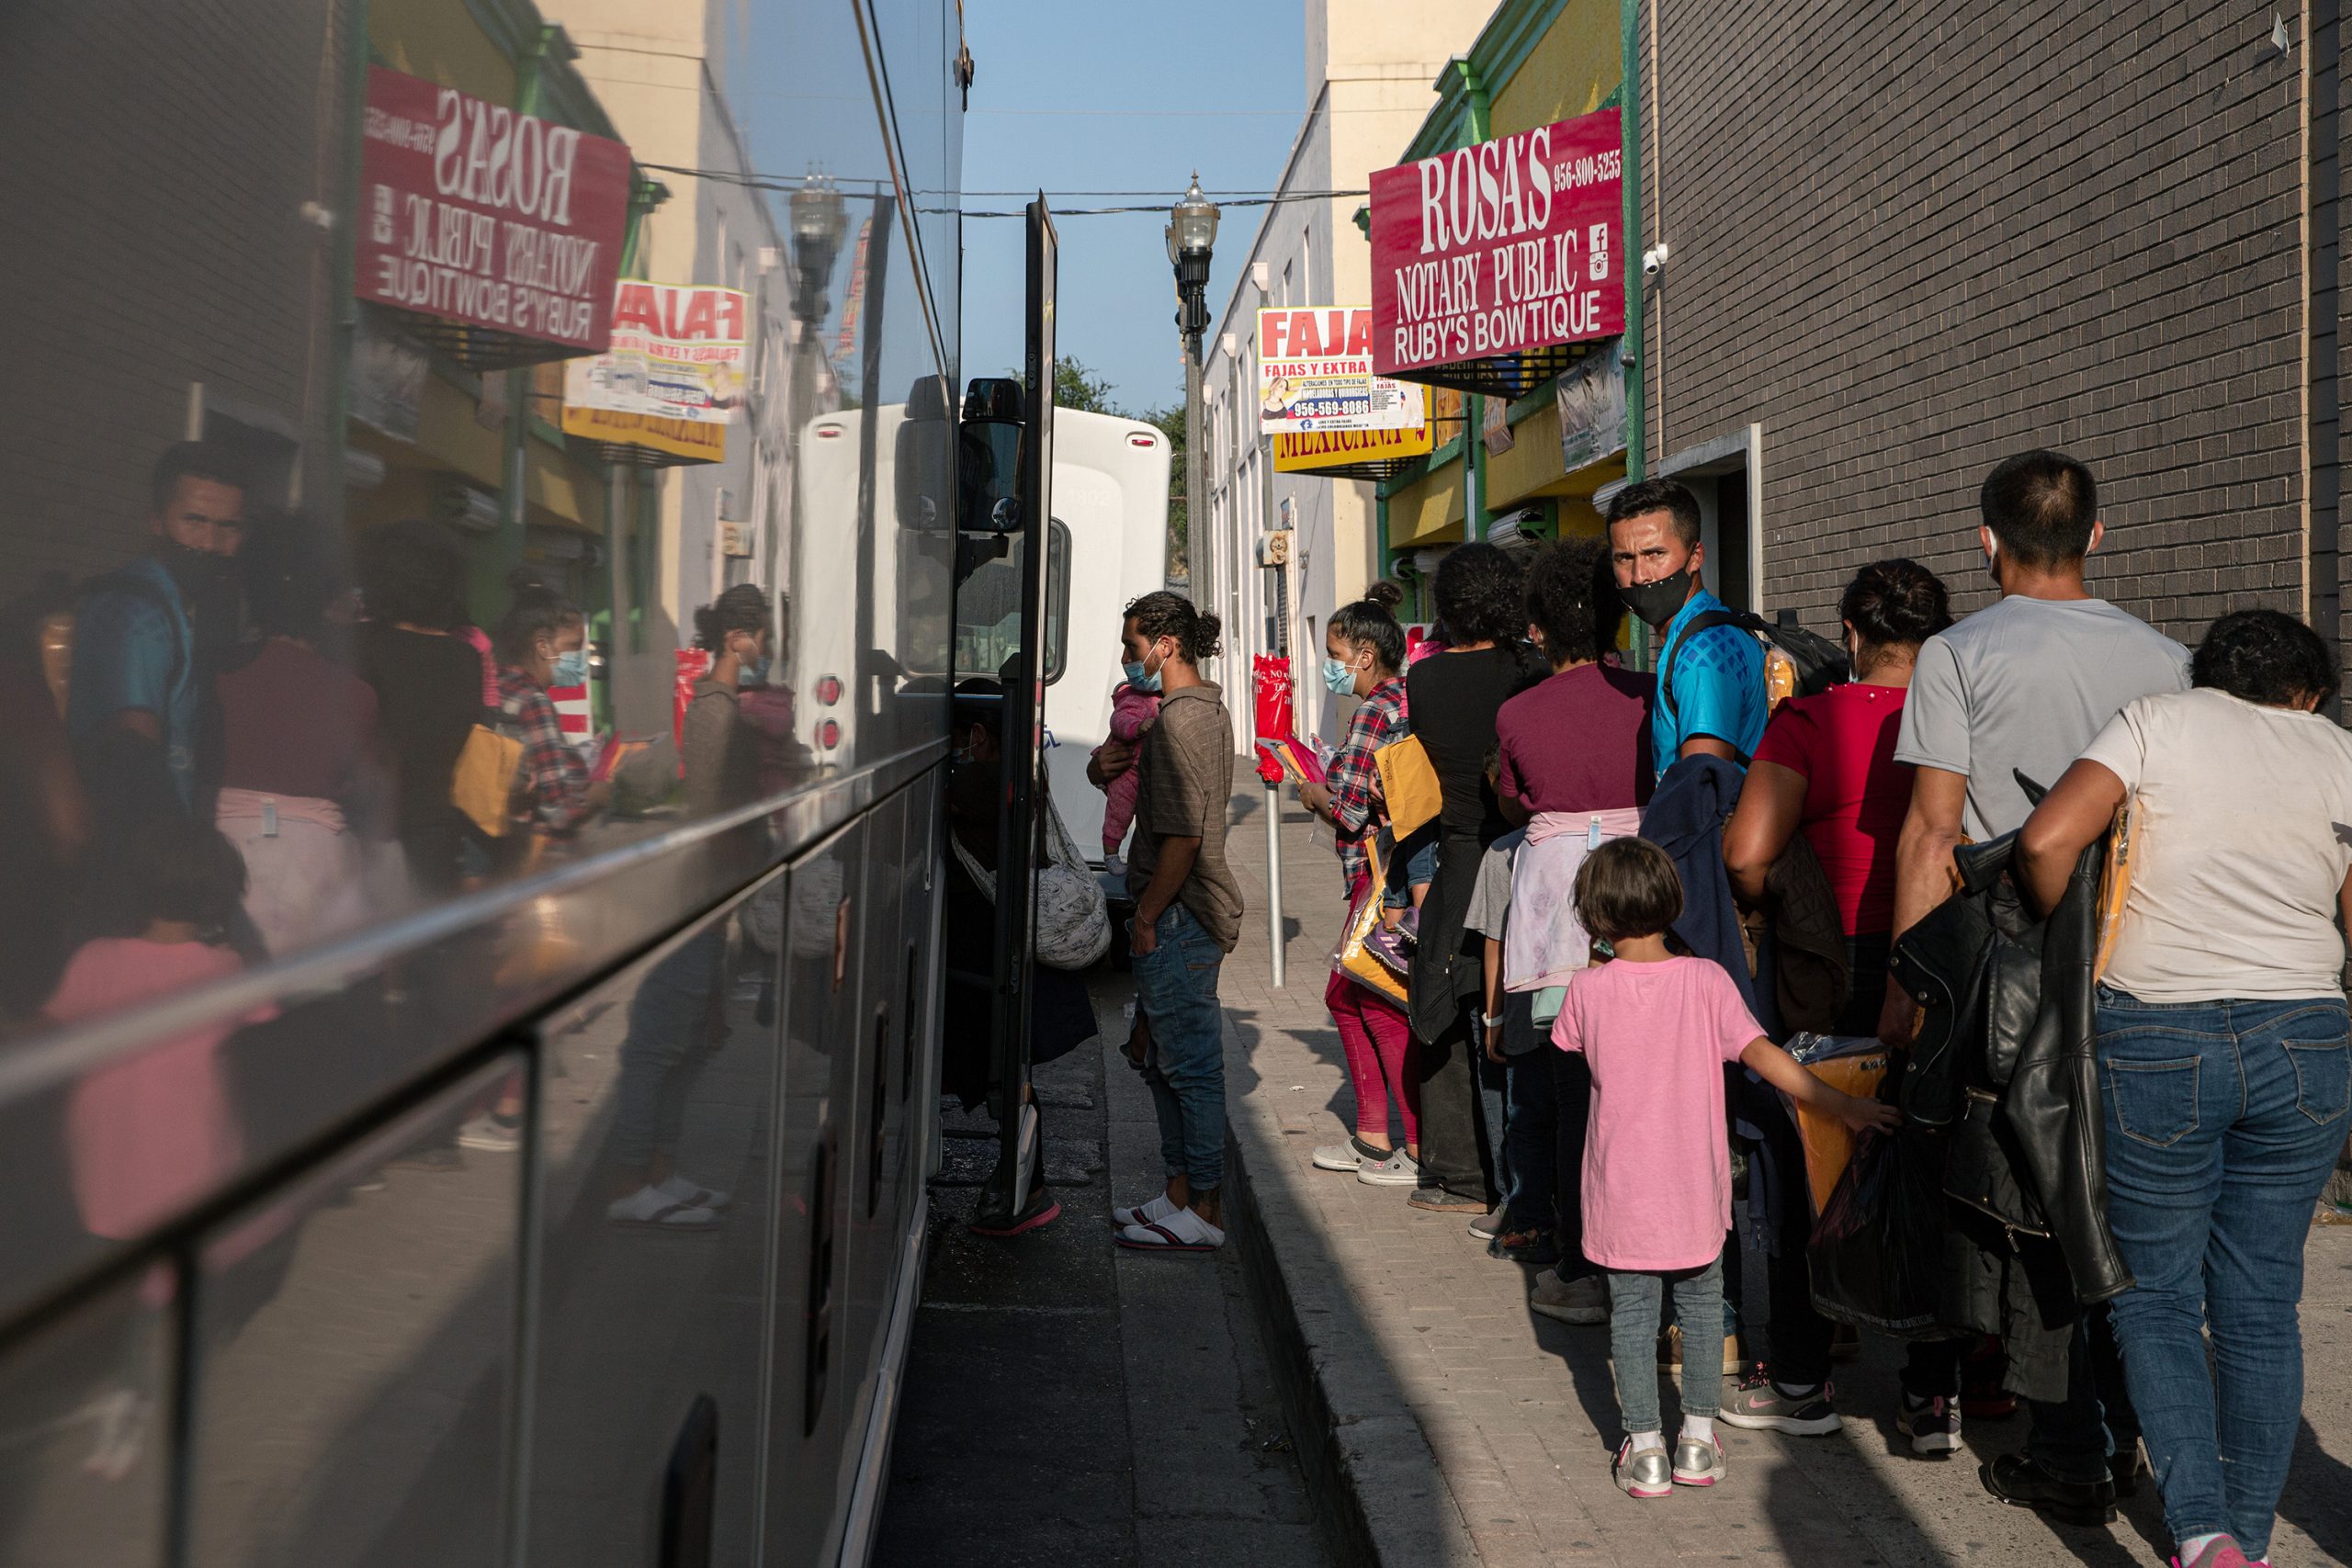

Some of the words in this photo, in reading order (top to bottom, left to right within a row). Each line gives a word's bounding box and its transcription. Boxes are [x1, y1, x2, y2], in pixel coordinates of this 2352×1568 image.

[1419, 126, 1552, 254] ROSA'S
[1554, 149, 1622, 193] 956-800-5255
[1395, 252, 1482, 324] NOTARY
[1492, 229, 1578, 307] PUBLIC
[1395, 315, 1469, 366] RUBY'S
[1475, 289, 1601, 352] BOWTIQUE
[1265, 363, 1306, 378] FAJAS
[1310, 363, 1318, 376] Y
[1323, 361, 1367, 375] EXTRA
[1295, 400, 1369, 417] 956-569-8086
